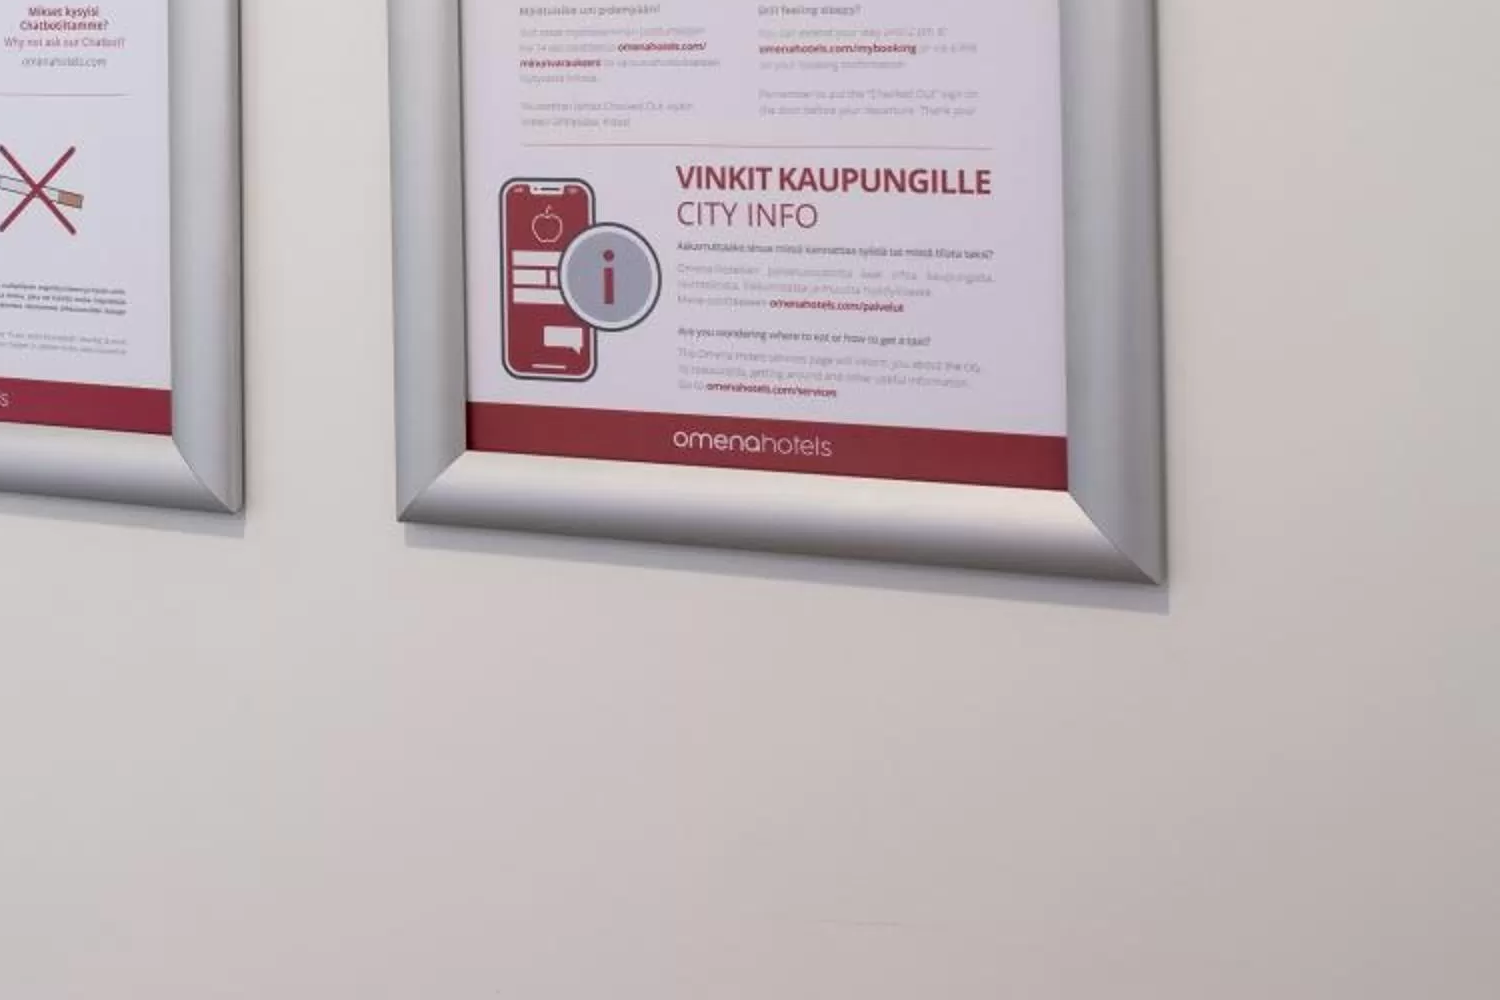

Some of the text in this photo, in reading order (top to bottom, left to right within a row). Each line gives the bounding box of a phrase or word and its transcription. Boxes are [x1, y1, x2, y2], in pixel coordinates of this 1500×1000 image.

[675, 164, 992, 196] VINKIT KAUPUNGILLE
[676, 201, 818, 230] CITY INFO
[672, 430, 833, 457] omenahotels
